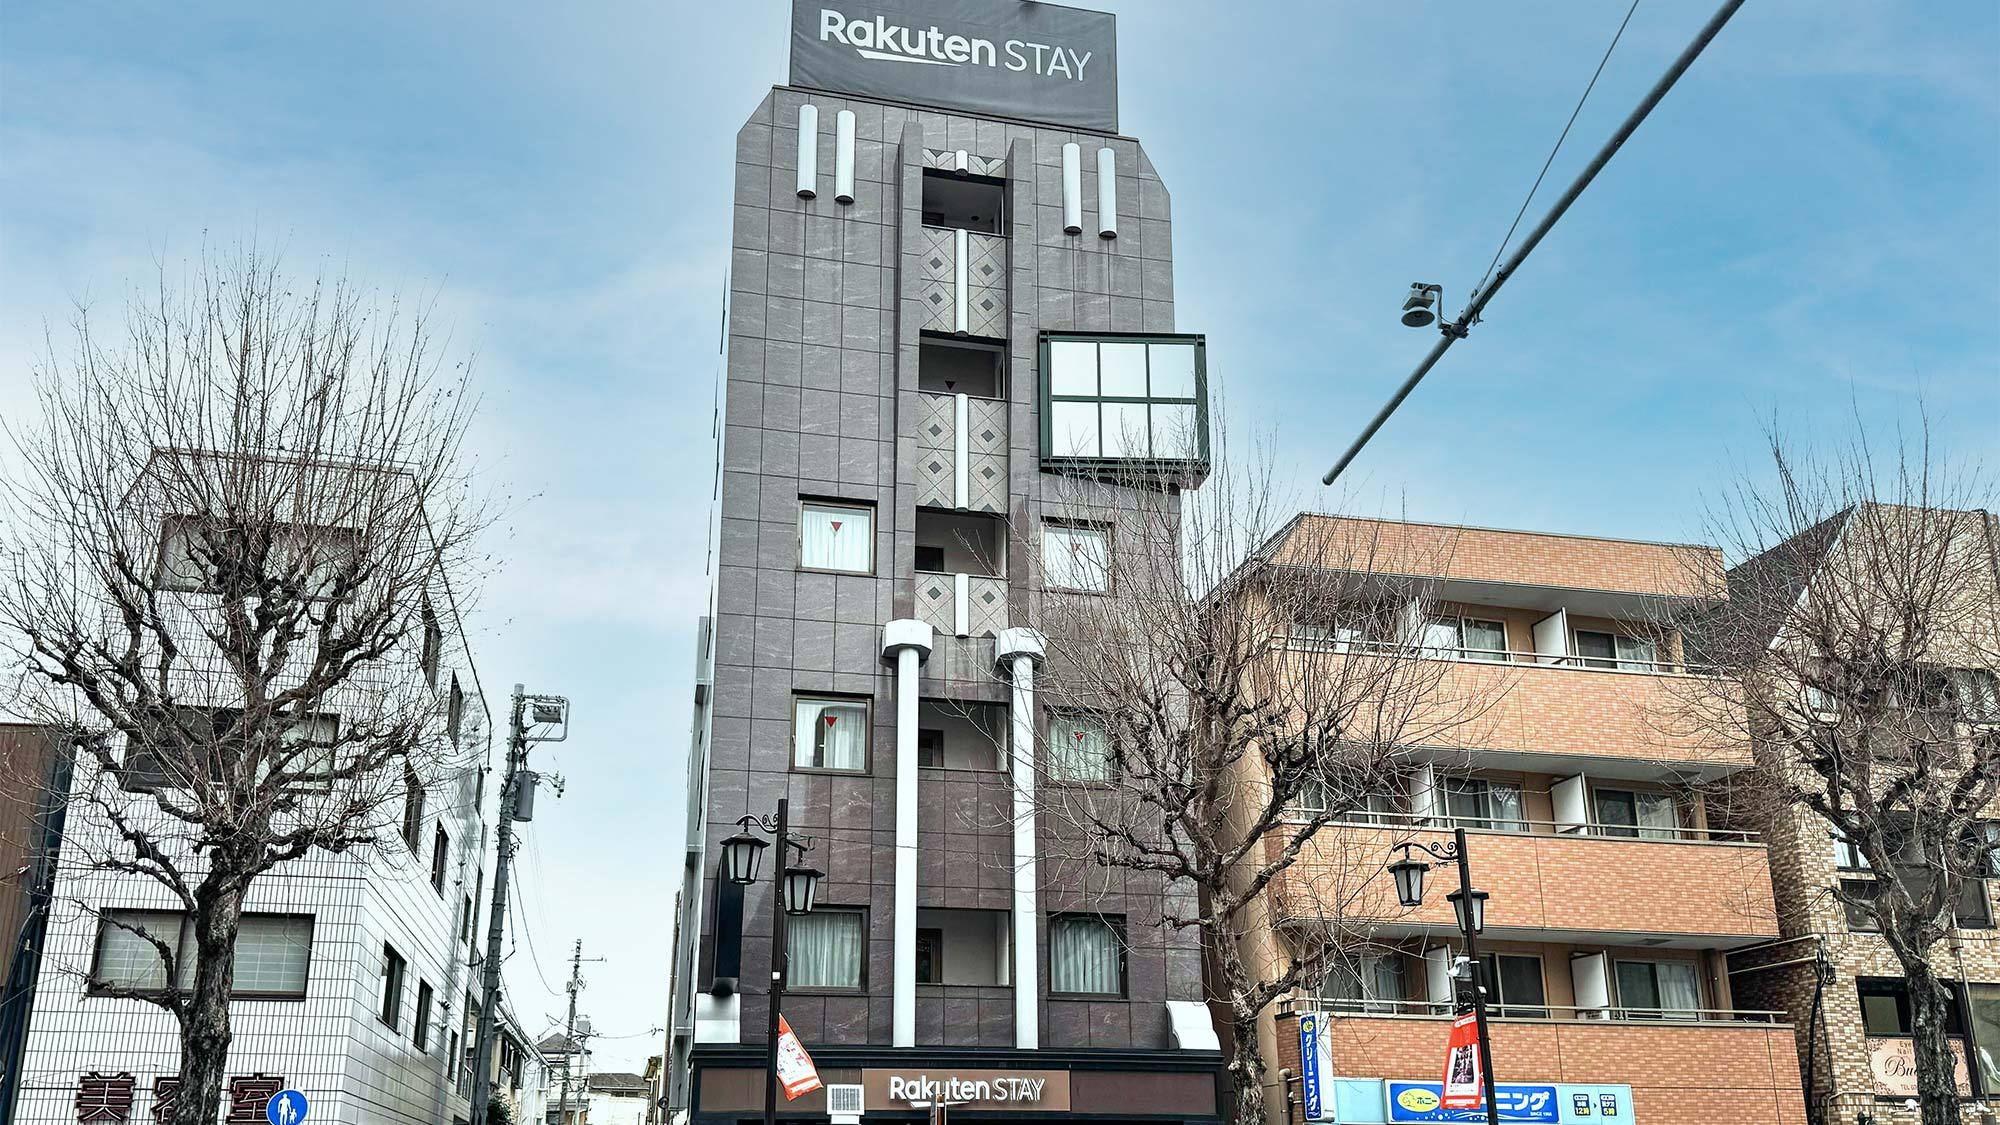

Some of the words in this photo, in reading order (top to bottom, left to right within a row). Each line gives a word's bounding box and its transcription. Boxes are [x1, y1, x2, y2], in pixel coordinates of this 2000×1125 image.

[819, 8, 997, 67] Rakuten
[1003, 39, 1092, 81] STAY
[889, 1075, 990, 1102] Rakuten
[992, 1077, 1046, 1102] STAY
